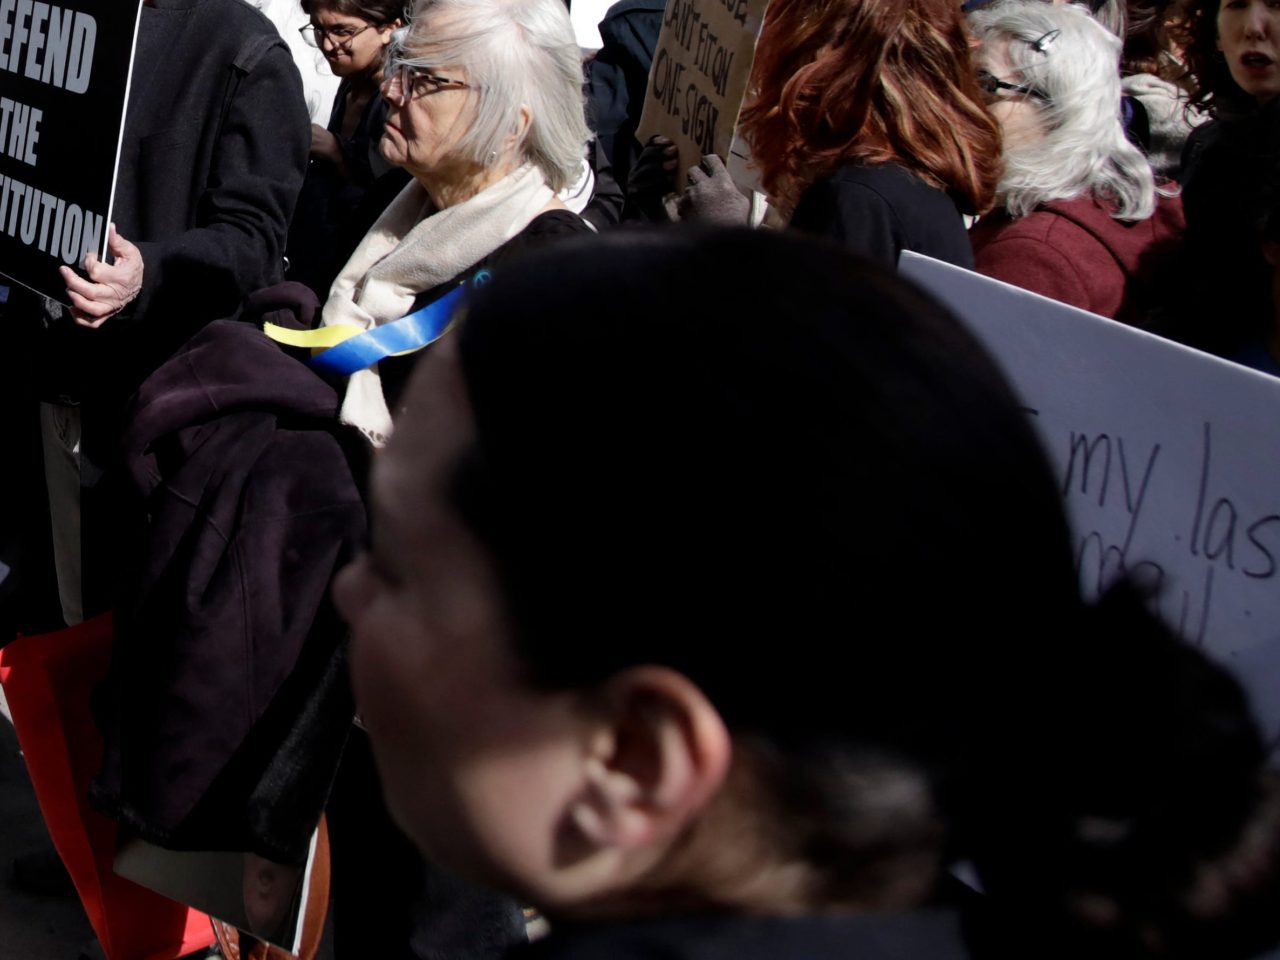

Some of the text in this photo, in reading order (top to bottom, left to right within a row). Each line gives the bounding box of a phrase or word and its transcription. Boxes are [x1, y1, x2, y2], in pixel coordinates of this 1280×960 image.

[653, 47, 719, 155] ONE SIGN
[1065, 430, 1161, 566] my
